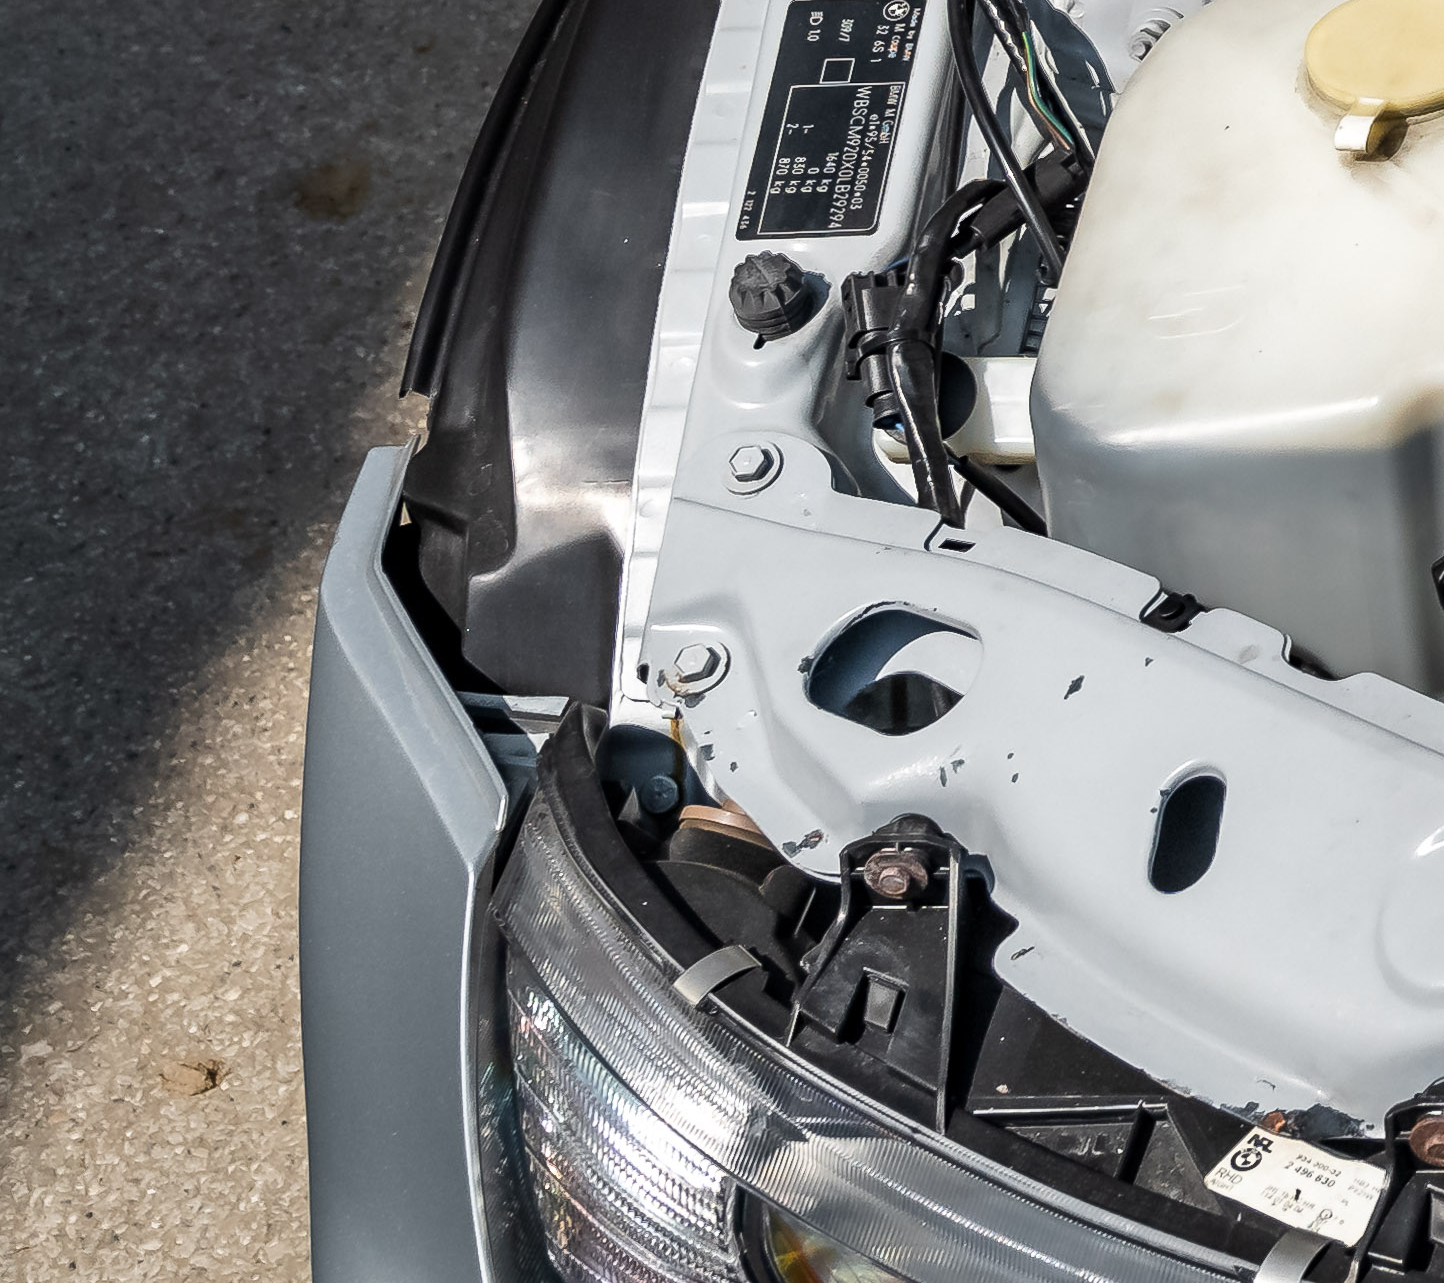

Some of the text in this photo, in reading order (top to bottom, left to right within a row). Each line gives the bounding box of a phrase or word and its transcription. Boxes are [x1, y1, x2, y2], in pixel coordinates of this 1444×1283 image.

[876, 25, 890, 35] 32
[894, 23, 906, 32] M
[879, 85, 899, 144] BMW M GmbH
[776, 157, 790, 175] 870
[791, 156, 806, 175] 830
[770, 180, 785, 194] kg
[785, 180, 801, 193] kg
[800, 179, 816, 193] kg
[816, 179, 832, 193] kg
[1215, 1167, 1243, 1185] RHD
[1284, 1161, 1313, 1178] 2 496
